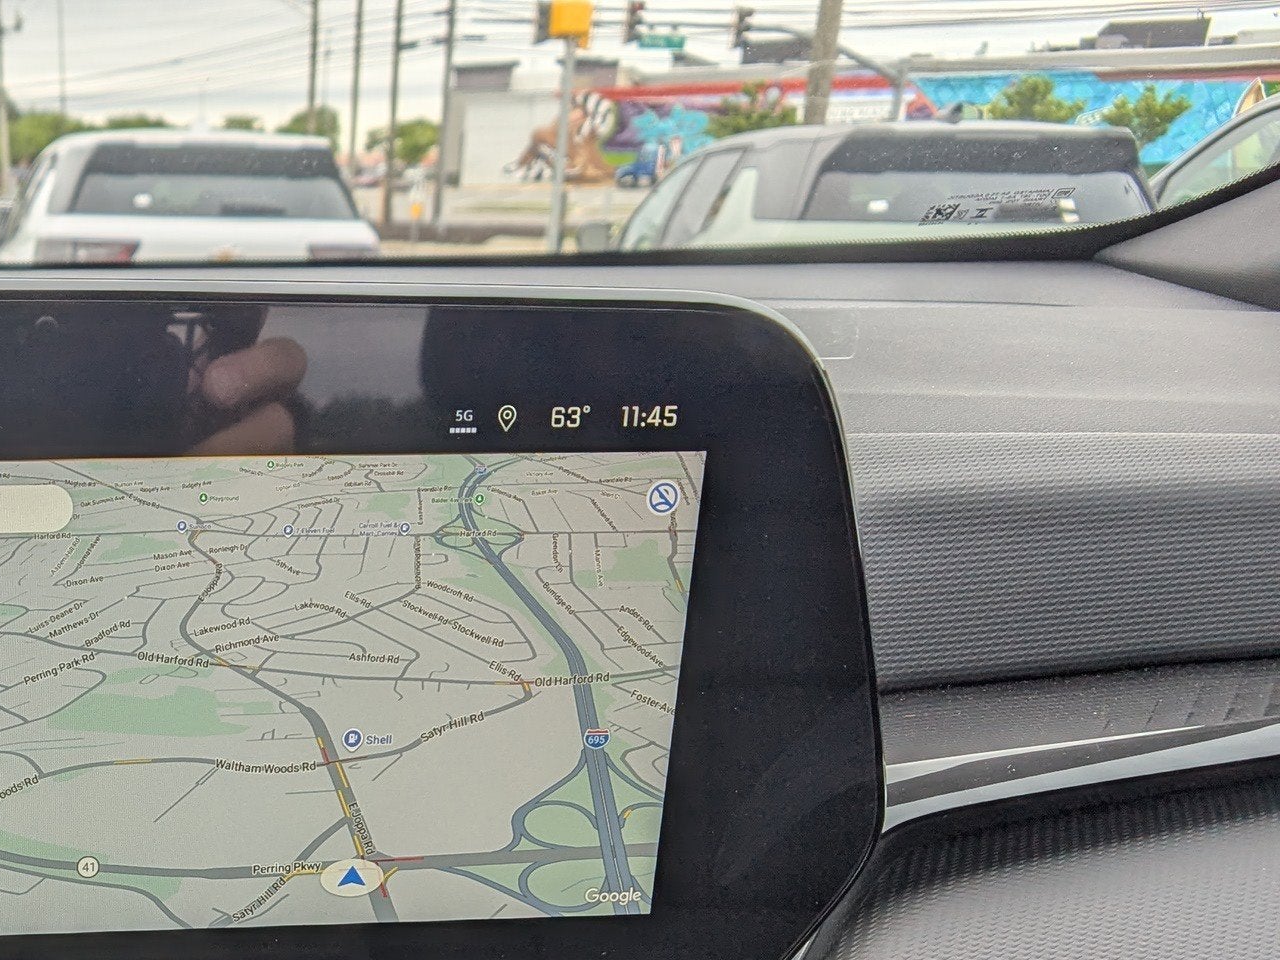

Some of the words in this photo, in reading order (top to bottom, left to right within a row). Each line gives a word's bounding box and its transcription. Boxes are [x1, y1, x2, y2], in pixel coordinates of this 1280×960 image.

[455, 410, 473, 422] 5G
[551, 405, 591, 428] 63°
[621, 405, 678, 427] 11:45
[34, 532, 59, 540] Harford
[60, 532, 71, 540] Rd
[154, 552, 175, 561] Mason
[178, 550, 192, 558] Ave
[154, 564, 173, 573] Dixon
[174, 562, 191, 570] Ave
[66, 578, 85, 587] Dixon
[86, 575, 104, 584] Ave
[344, 590, 359, 603] Ellis
[360, 598, 371, 609] Rd
[426, 580, 464, 600] Woodcroft
[464, 594, 475, 603] Rd
[48, 608, 74, 624] Deane
[73, 602, 84, 612] Dr
[294, 602, 335, 614] Lakewood
[335, 608, 347, 619] Rd
[402, 600, 438, 623] Stockwell
[438, 614, 449, 625] Rd
[619, 604, 643, 623] Anders
[48, 616, 90, 639] Matthews
[89, 610, 100, 622] Dr
[84, 623, 120, 648] Bradford
[119, 620, 132, 629] Rd
[194, 622, 237, 638] Lakewood
[238, 617, 251, 626] Rd
[214, 636, 261, 654] Richmond
[262, 634, 280, 643] Ave
[452, 622, 491, 645] Stockwell
[490, 638, 504, 648] Rd
[618, 625, 652, 658] Edgewood
[137, 652, 156, 662] Old
[158, 654, 194, 667] Harford
[196, 658, 209, 669] Rd
[349, 652, 386, 664] Ashford
[387, 654, 400, 664] Rd
[24, 668, 59, 685] Perring
[58, 658, 81, 674] Park
[82, 652, 96, 664] Rd
[488, 660, 509, 675] Ellis
[508, 670, 522, 682] Rd
[534, 676, 552, 687] Old
[554, 674, 595, 686] Harford
[596, 672, 610, 682] Rd
[630, 689, 659, 708] Foster
[420, 725, 447, 742] Satyr
[448, 716, 467, 730] Hill
[470, 711, 485, 724] Rd
[366, 734, 393, 745] Shell
[588, 735, 606, 745] 695
[215, 758, 261, 773] Waltham
[263, 762, 299, 774] Woods
[302, 760, 317, 772] Rd
[24, 774, 40, 788] Rd
[352, 812, 369, 841] Joppa
[364, 840, 376, 855] Rd
[82, 862, 96, 872] 41
[252, 864, 291, 875] Perring
[293, 862, 321, 874] Pkwy
[232, 900, 259, 922] Satyr
[256, 888, 274, 906] Hill
[272, 877, 287, 893] Rd
[584, 888, 642, 906] Google
